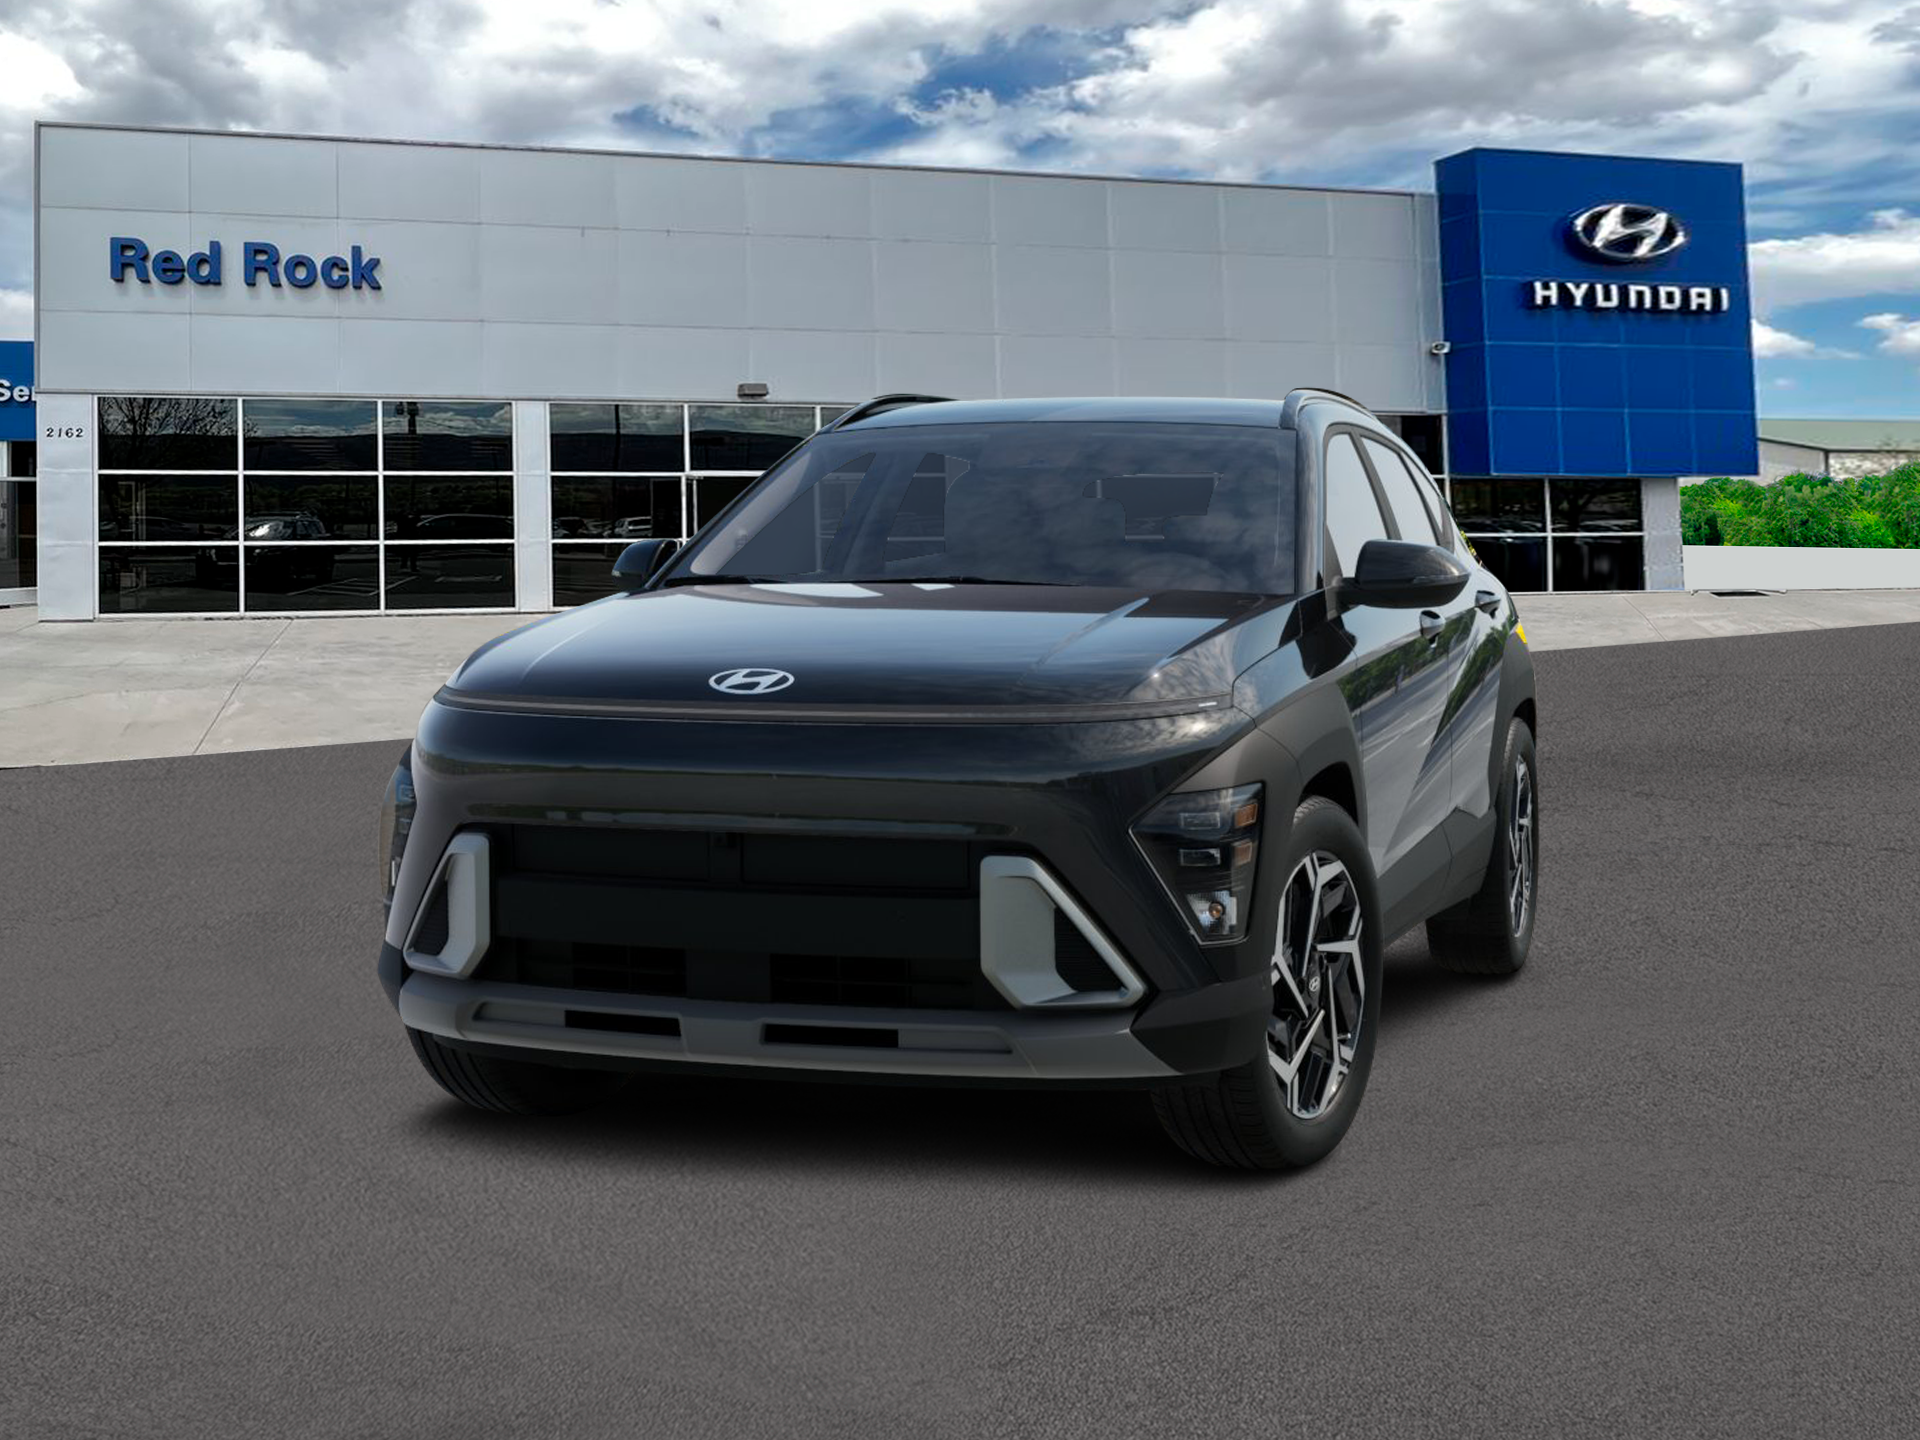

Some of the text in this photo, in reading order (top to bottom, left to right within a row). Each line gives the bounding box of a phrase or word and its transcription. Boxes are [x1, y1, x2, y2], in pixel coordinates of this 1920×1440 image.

[109, 236, 382, 291] Red Rock
[1533, 280, 1730, 311] HYUNDAI
[46, 427, 84, 438] 2162
